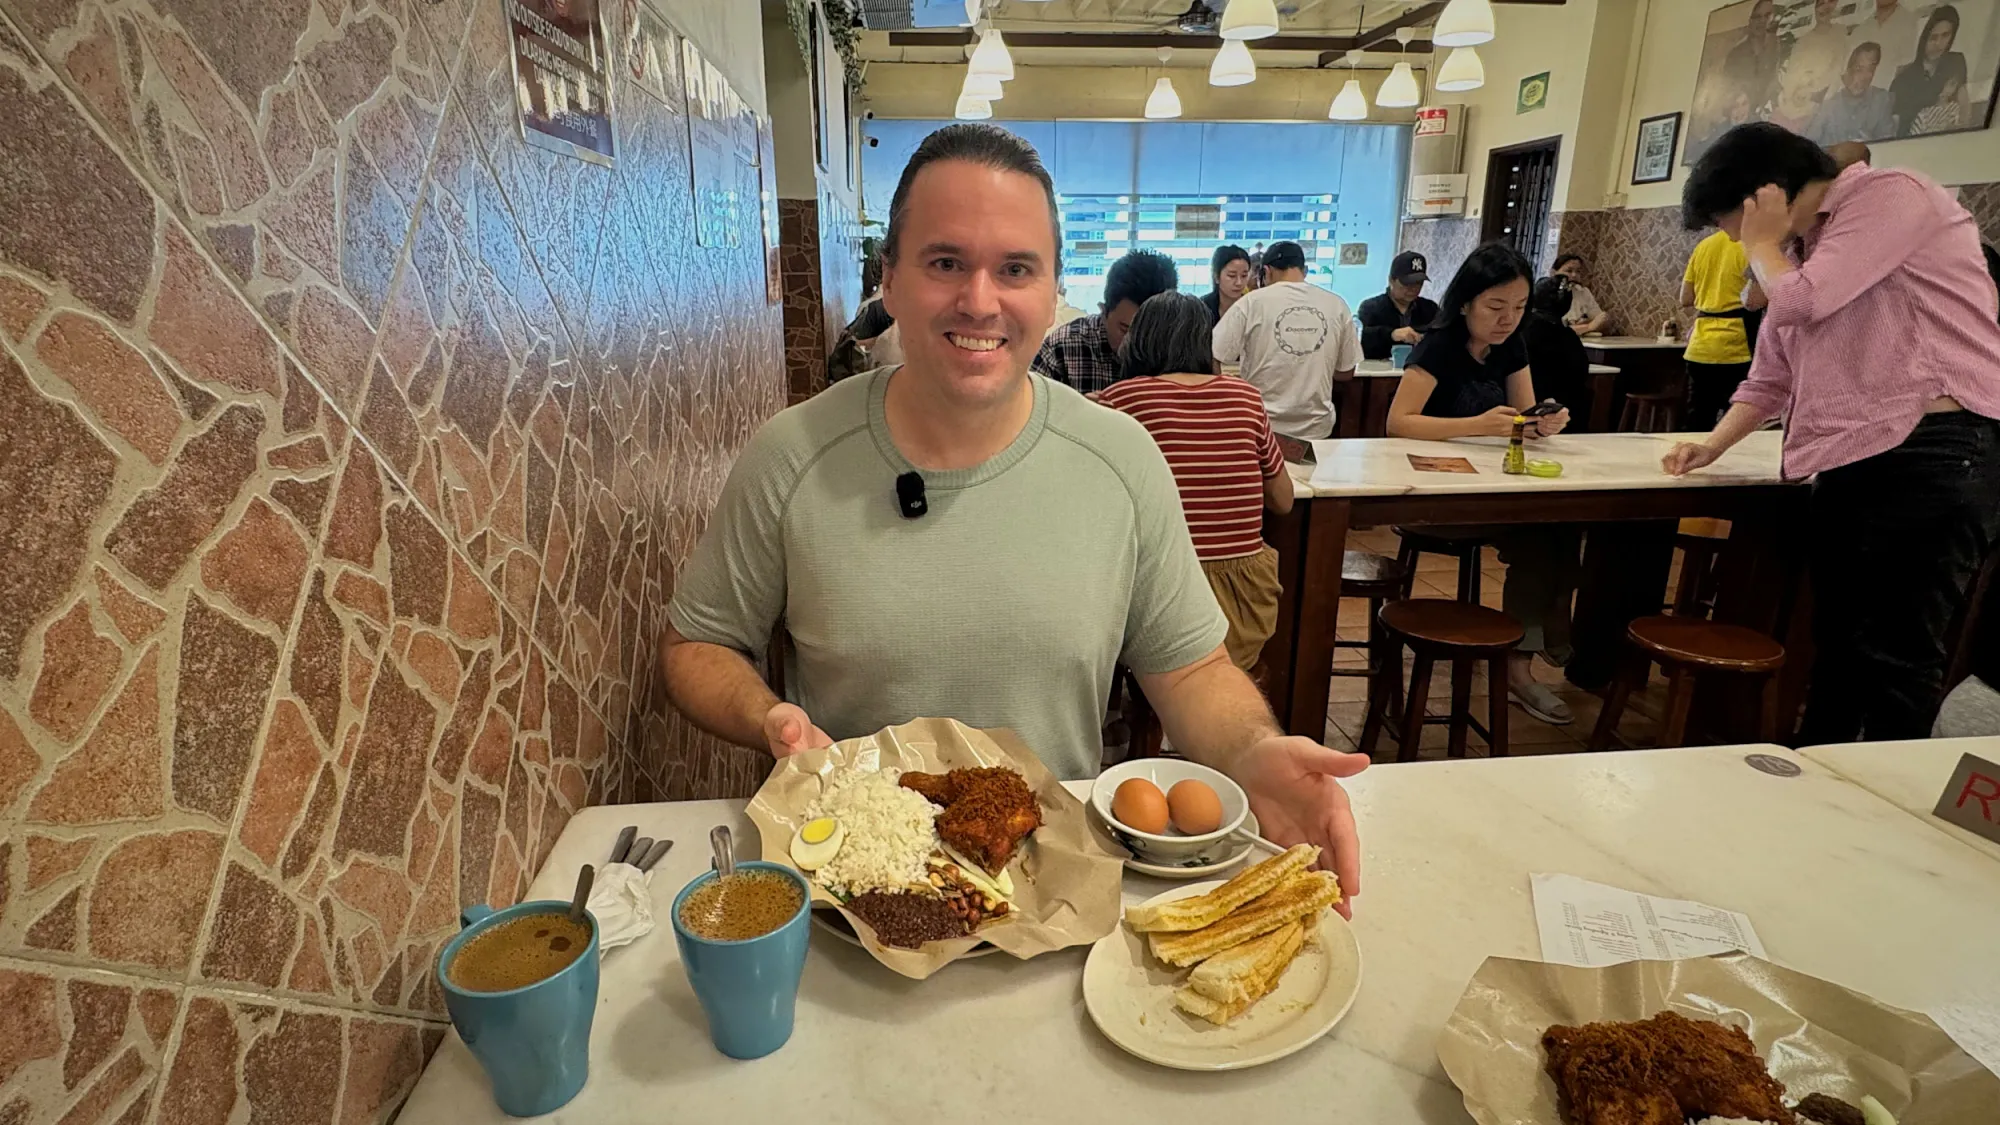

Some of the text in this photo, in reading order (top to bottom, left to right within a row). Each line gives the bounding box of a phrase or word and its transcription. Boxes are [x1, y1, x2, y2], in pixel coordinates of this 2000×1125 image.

[520, 4, 546, 38] OUTSIDE
[545, 20, 563, 48] FOOD
[519, 34, 553, 70] DILARANG
[1411, 257, 1423, 271] NY
